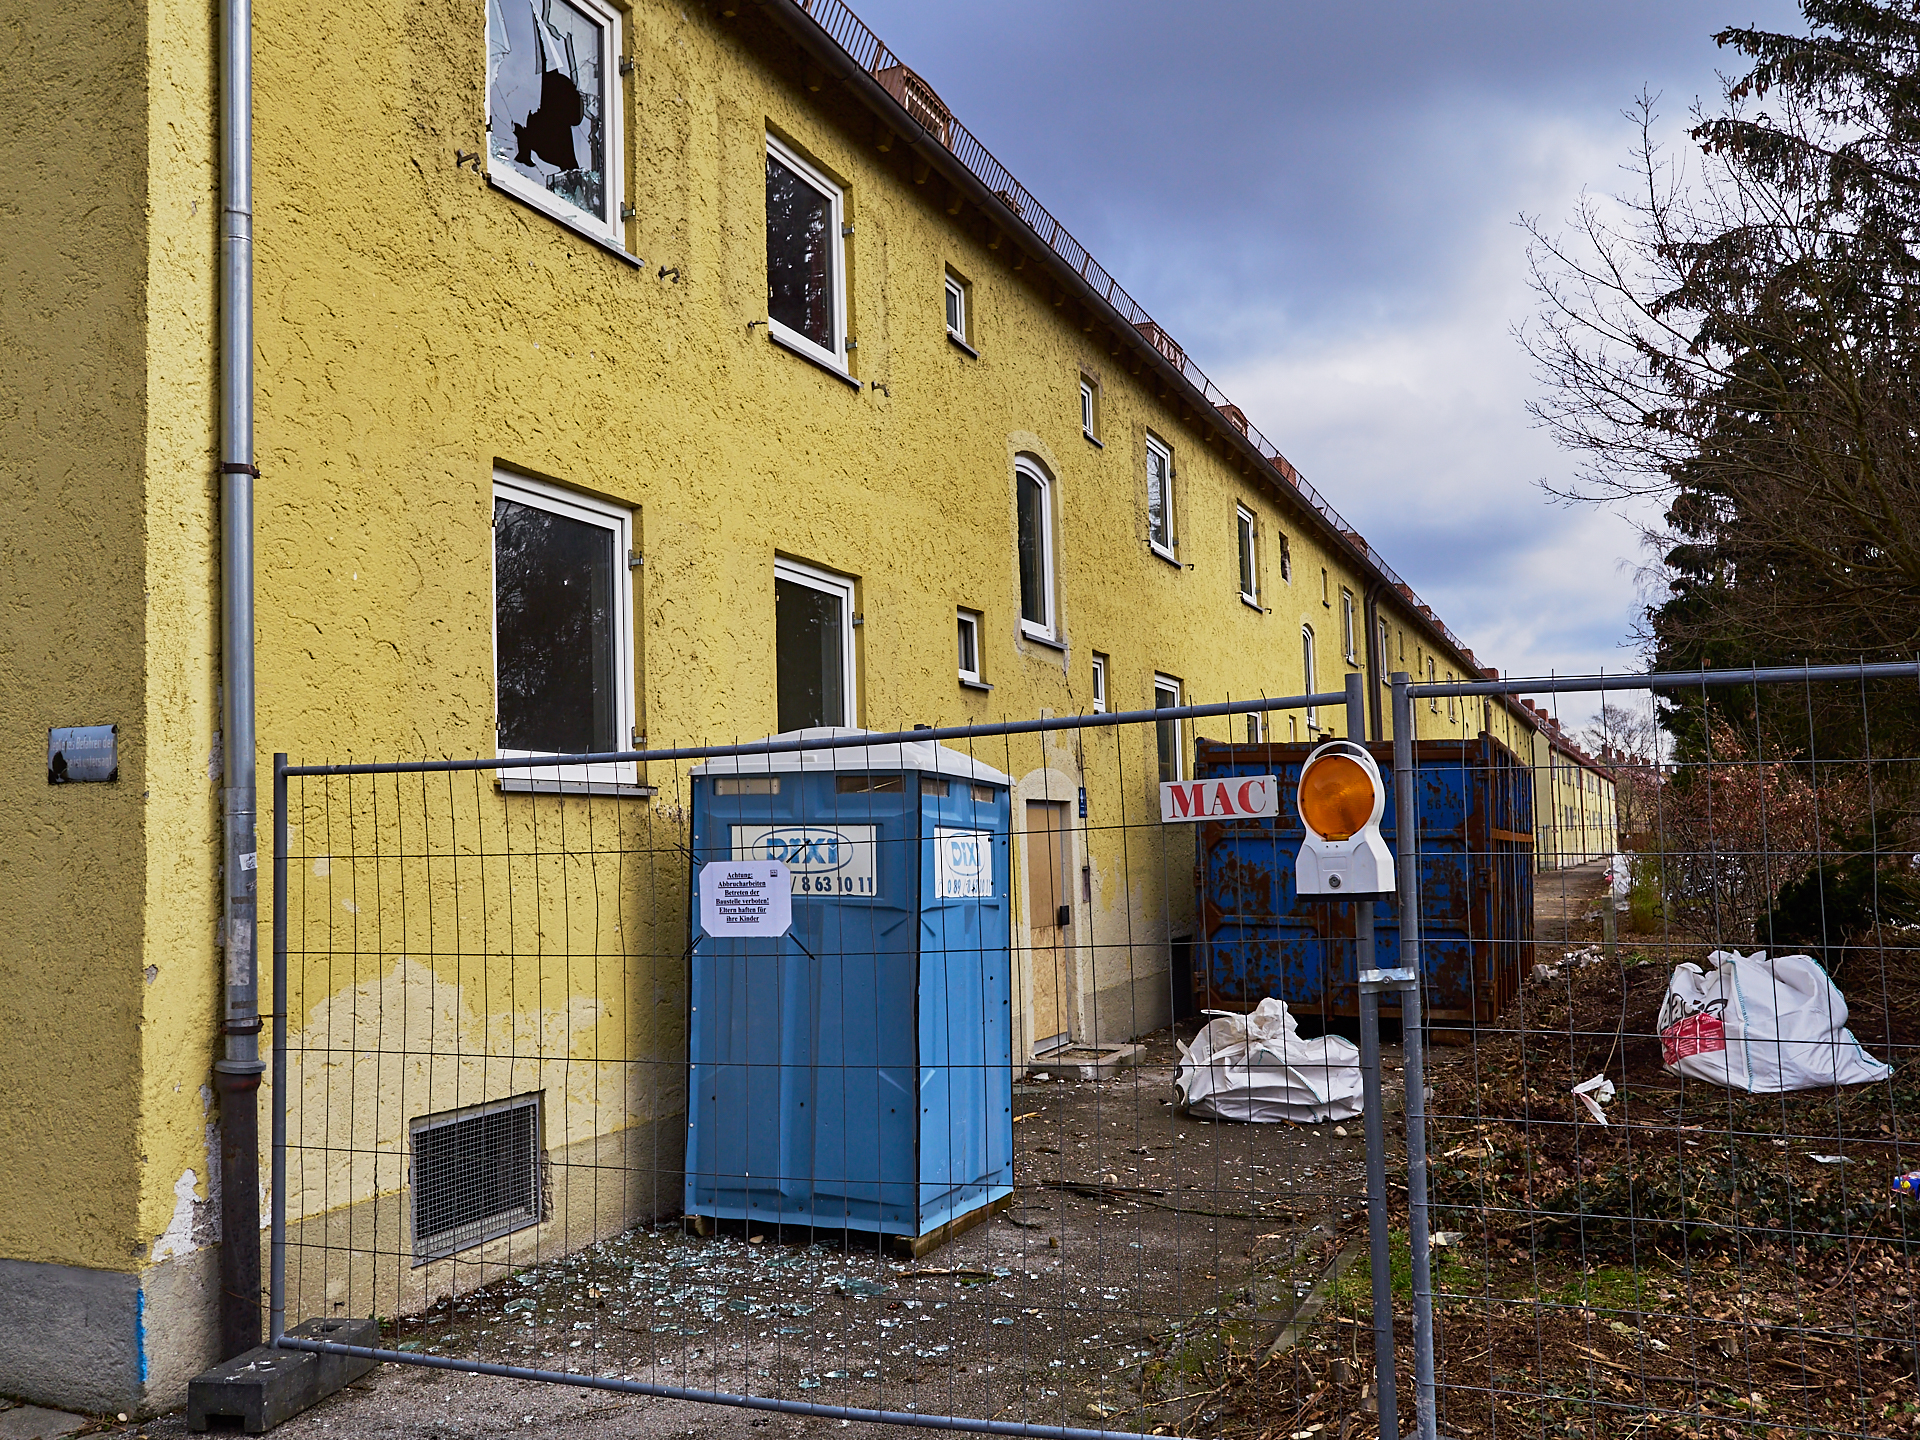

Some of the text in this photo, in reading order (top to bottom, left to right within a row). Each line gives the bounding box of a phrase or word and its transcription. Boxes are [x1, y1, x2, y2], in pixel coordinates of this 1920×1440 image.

[76, 736, 102, 749] Befahren
[103, 735, 114, 748] der
[1166, 780, 1266, 818] MAC
[727, 872, 753, 880] Achtung:
[718, 880, 767, 888] Abbrucharbeiten
[802, 876, 811, 892] 8
[815, 876, 832, 892] 63
[837, 876, 853, 892] 10
[858, 876, 872, 892] 11
[725, 889, 760, 897] Betreten der
[716, 897, 769, 906] Baustelle verboten!
[719, 906, 767, 915] Eltern haften für
[726, 915, 760, 923] ihre Kinder
